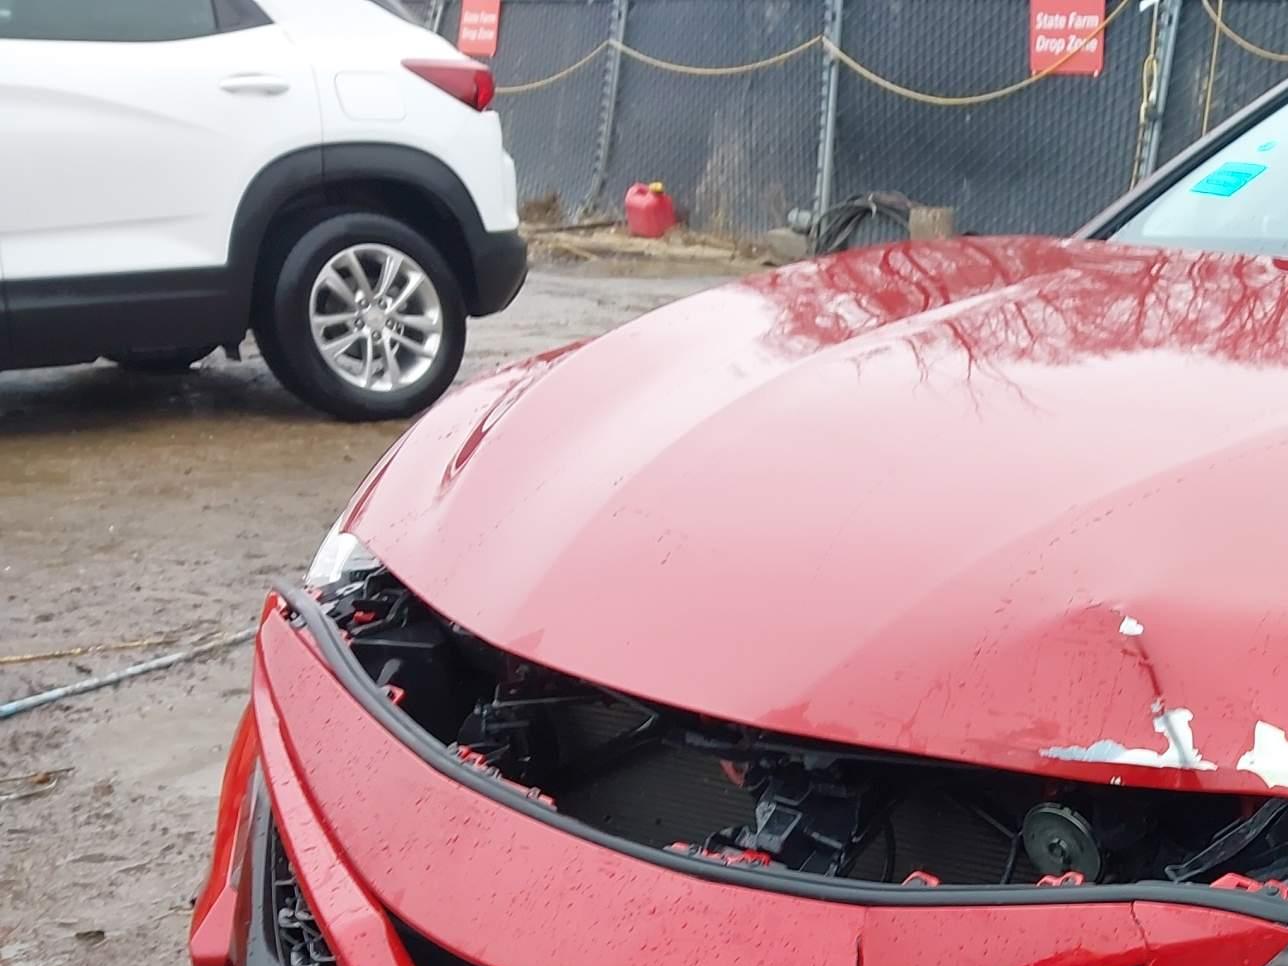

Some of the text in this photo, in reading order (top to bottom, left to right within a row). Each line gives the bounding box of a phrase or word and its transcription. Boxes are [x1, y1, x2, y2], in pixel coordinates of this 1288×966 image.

[1035, 12, 1099, 30] State Farm
[1035, 34, 1065, 55] Drop
